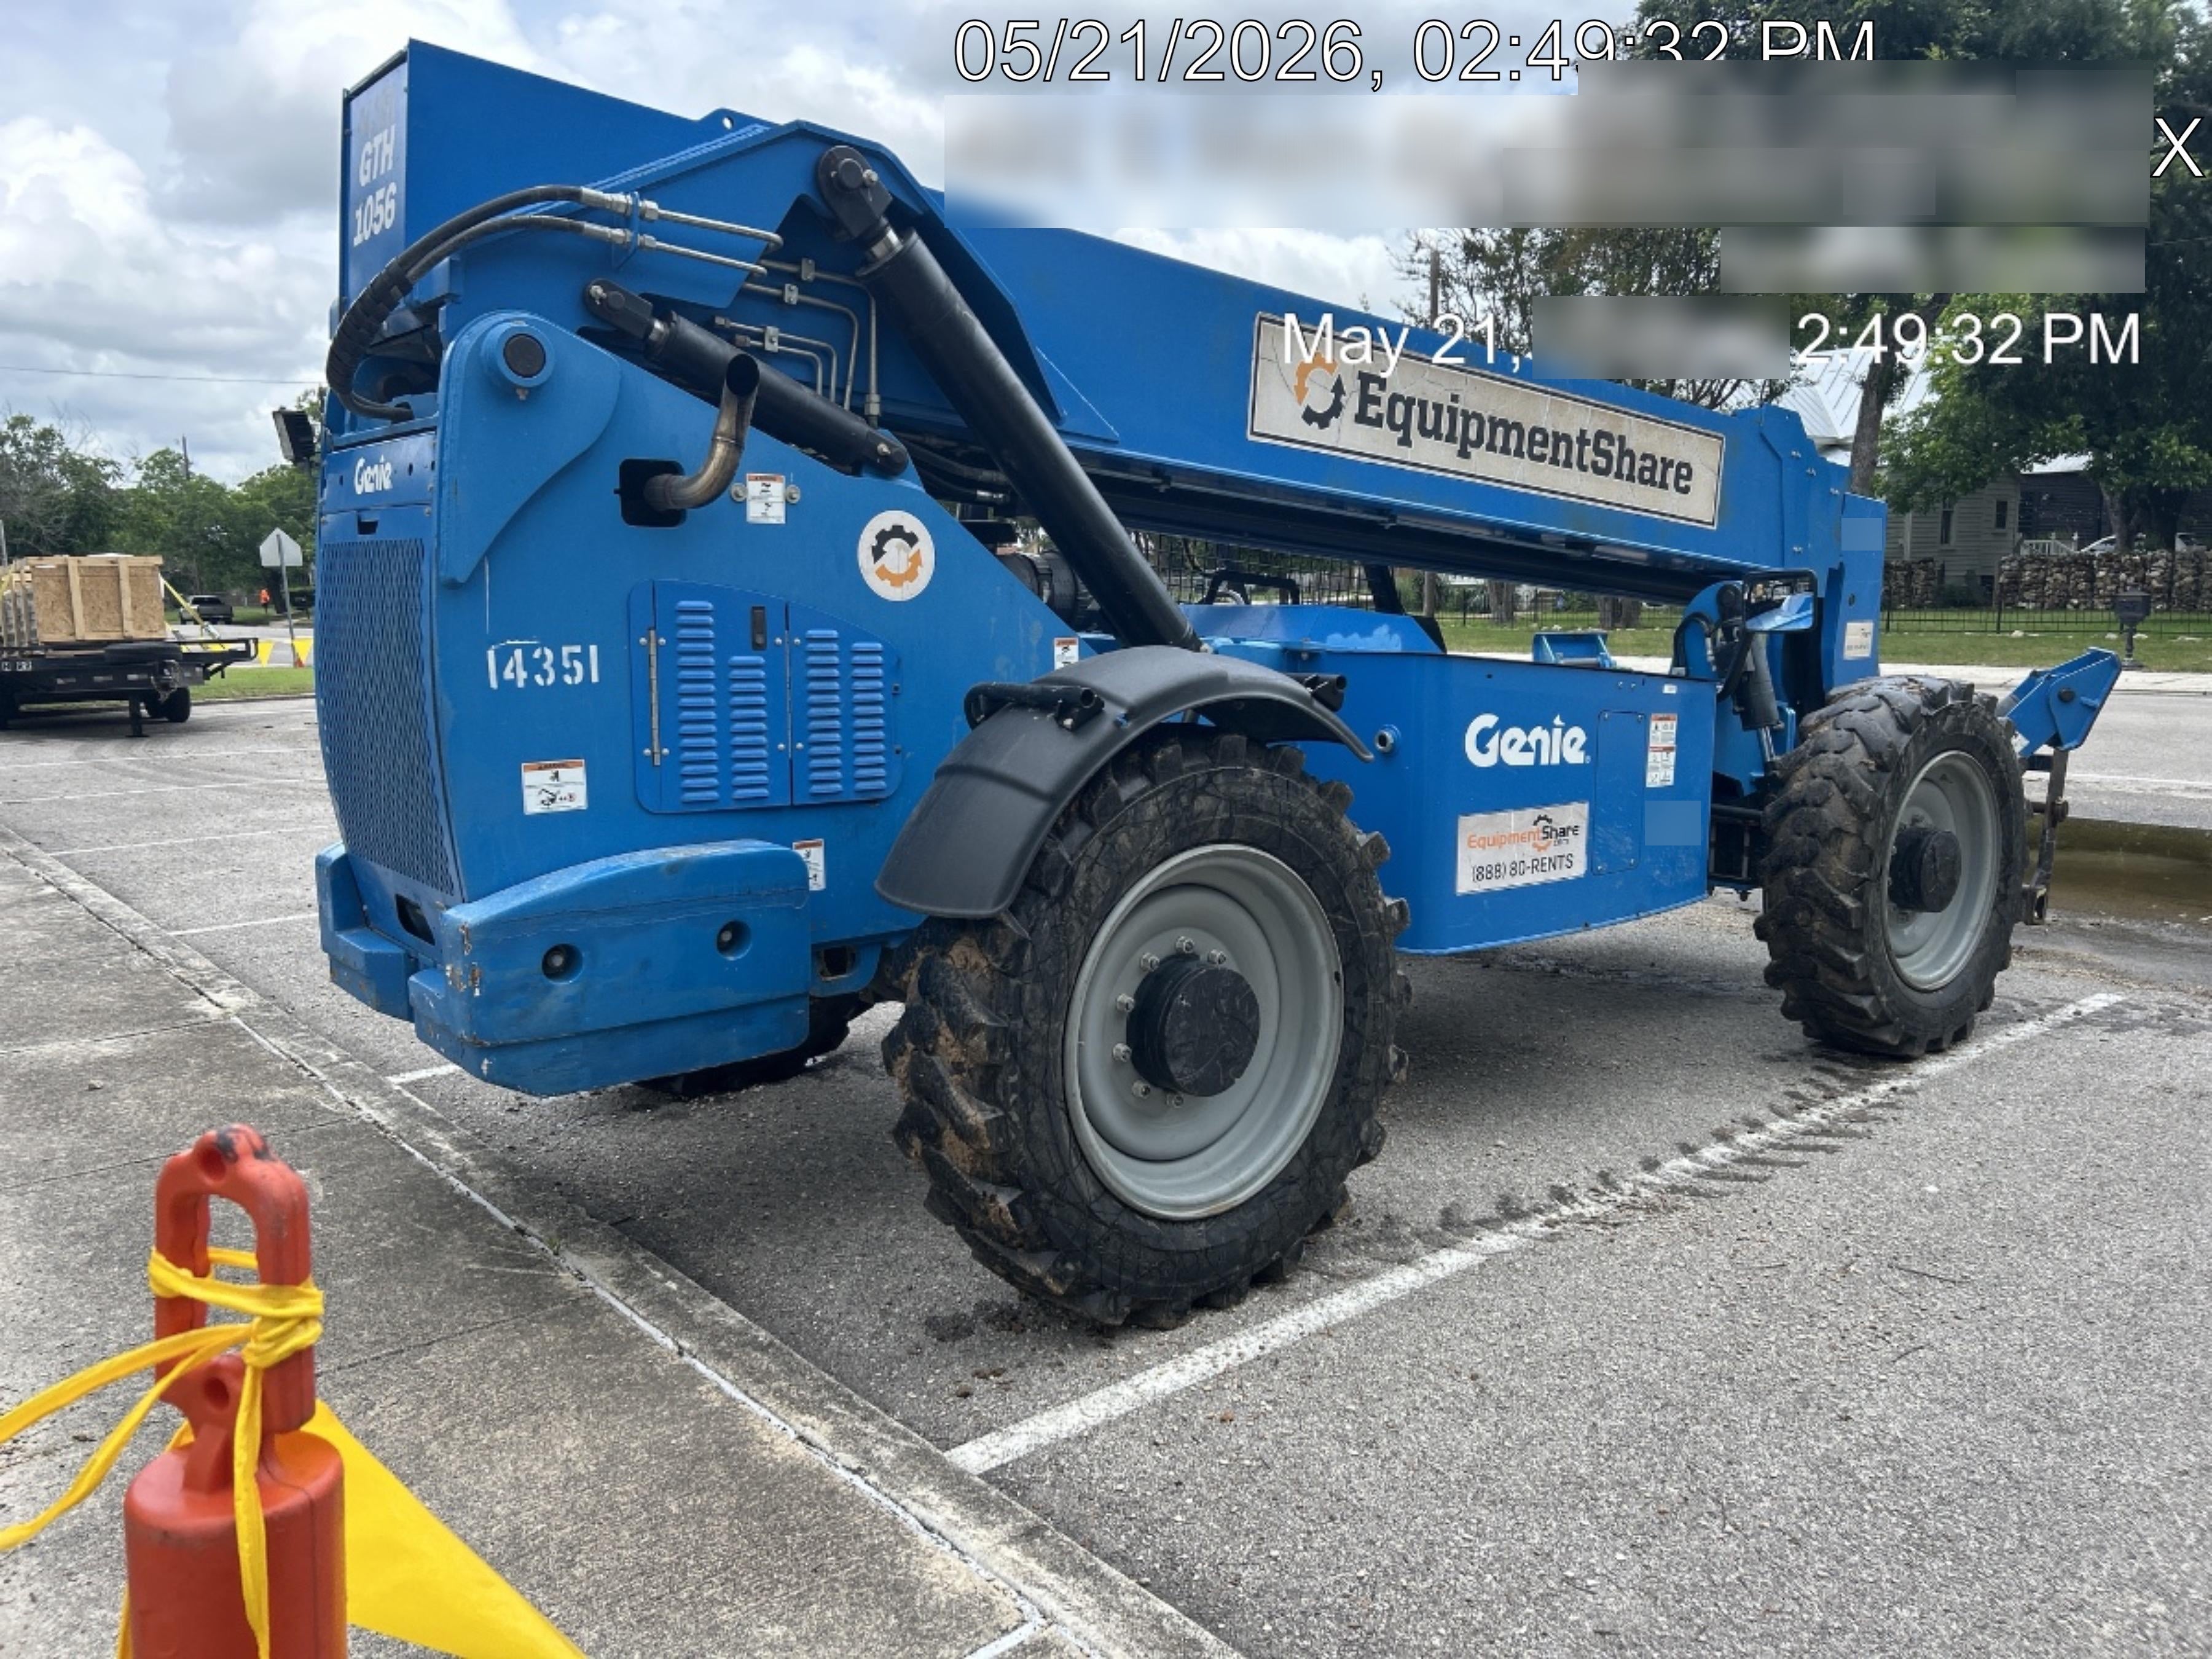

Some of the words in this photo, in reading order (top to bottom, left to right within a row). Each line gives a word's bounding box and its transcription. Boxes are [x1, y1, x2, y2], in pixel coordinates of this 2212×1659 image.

[359, 124, 395, 186] GTH
[353, 181, 396, 246] 1056
[1354, 371, 1694, 495] EquipmentShare
[355, 455, 393, 495] Genie
[487, 644, 600, 689] 14351
[1465, 713, 1588, 768] Genie
[1467, 825, 1580, 850] EquipmentShare
[1472, 861, 1505, 883] (888)
[1509, 853, 1574, 877] 80-RENTS
